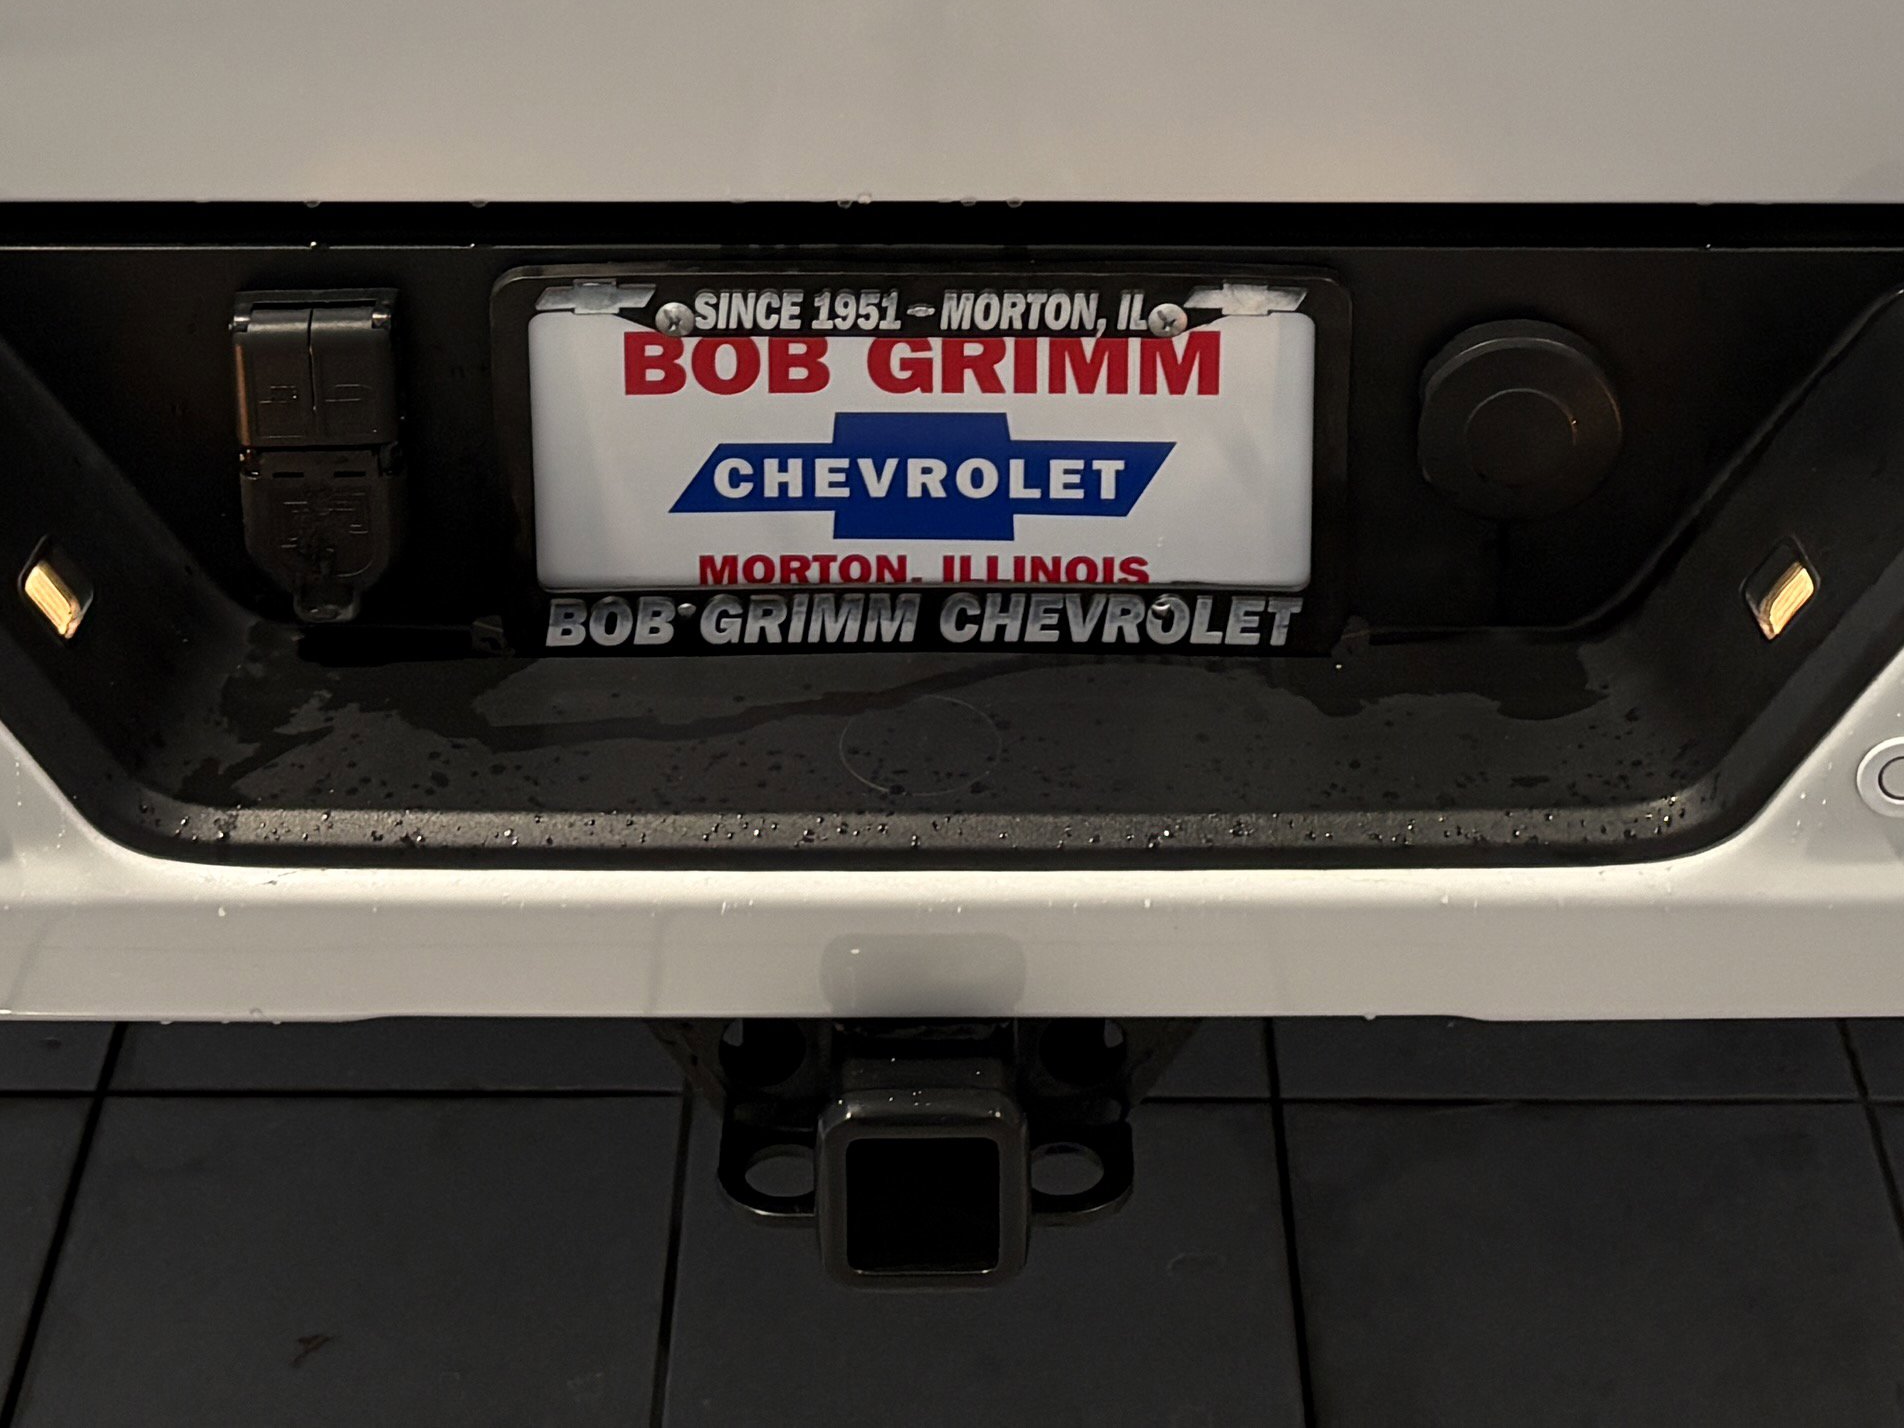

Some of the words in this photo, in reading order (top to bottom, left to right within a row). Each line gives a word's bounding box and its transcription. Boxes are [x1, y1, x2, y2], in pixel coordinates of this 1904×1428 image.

[695, 290, 803, 331] SINCE
[811, 290, 902, 331] 1951
[940, 290, 1107, 338] MORTON,
[1117, 290, 1147, 331] IL
[624, 331, 830, 395] BOB
[867, 331, 1221, 395] GRIMM
[713, 457, 1126, 500] CHEVROLET
[942, 554, 1150, 584] ILLINOIS
[546, 595, 678, 647] BOB
[699, 592, 923, 645] GRIMM
[939, 591, 1304, 647] CHEVROLET
